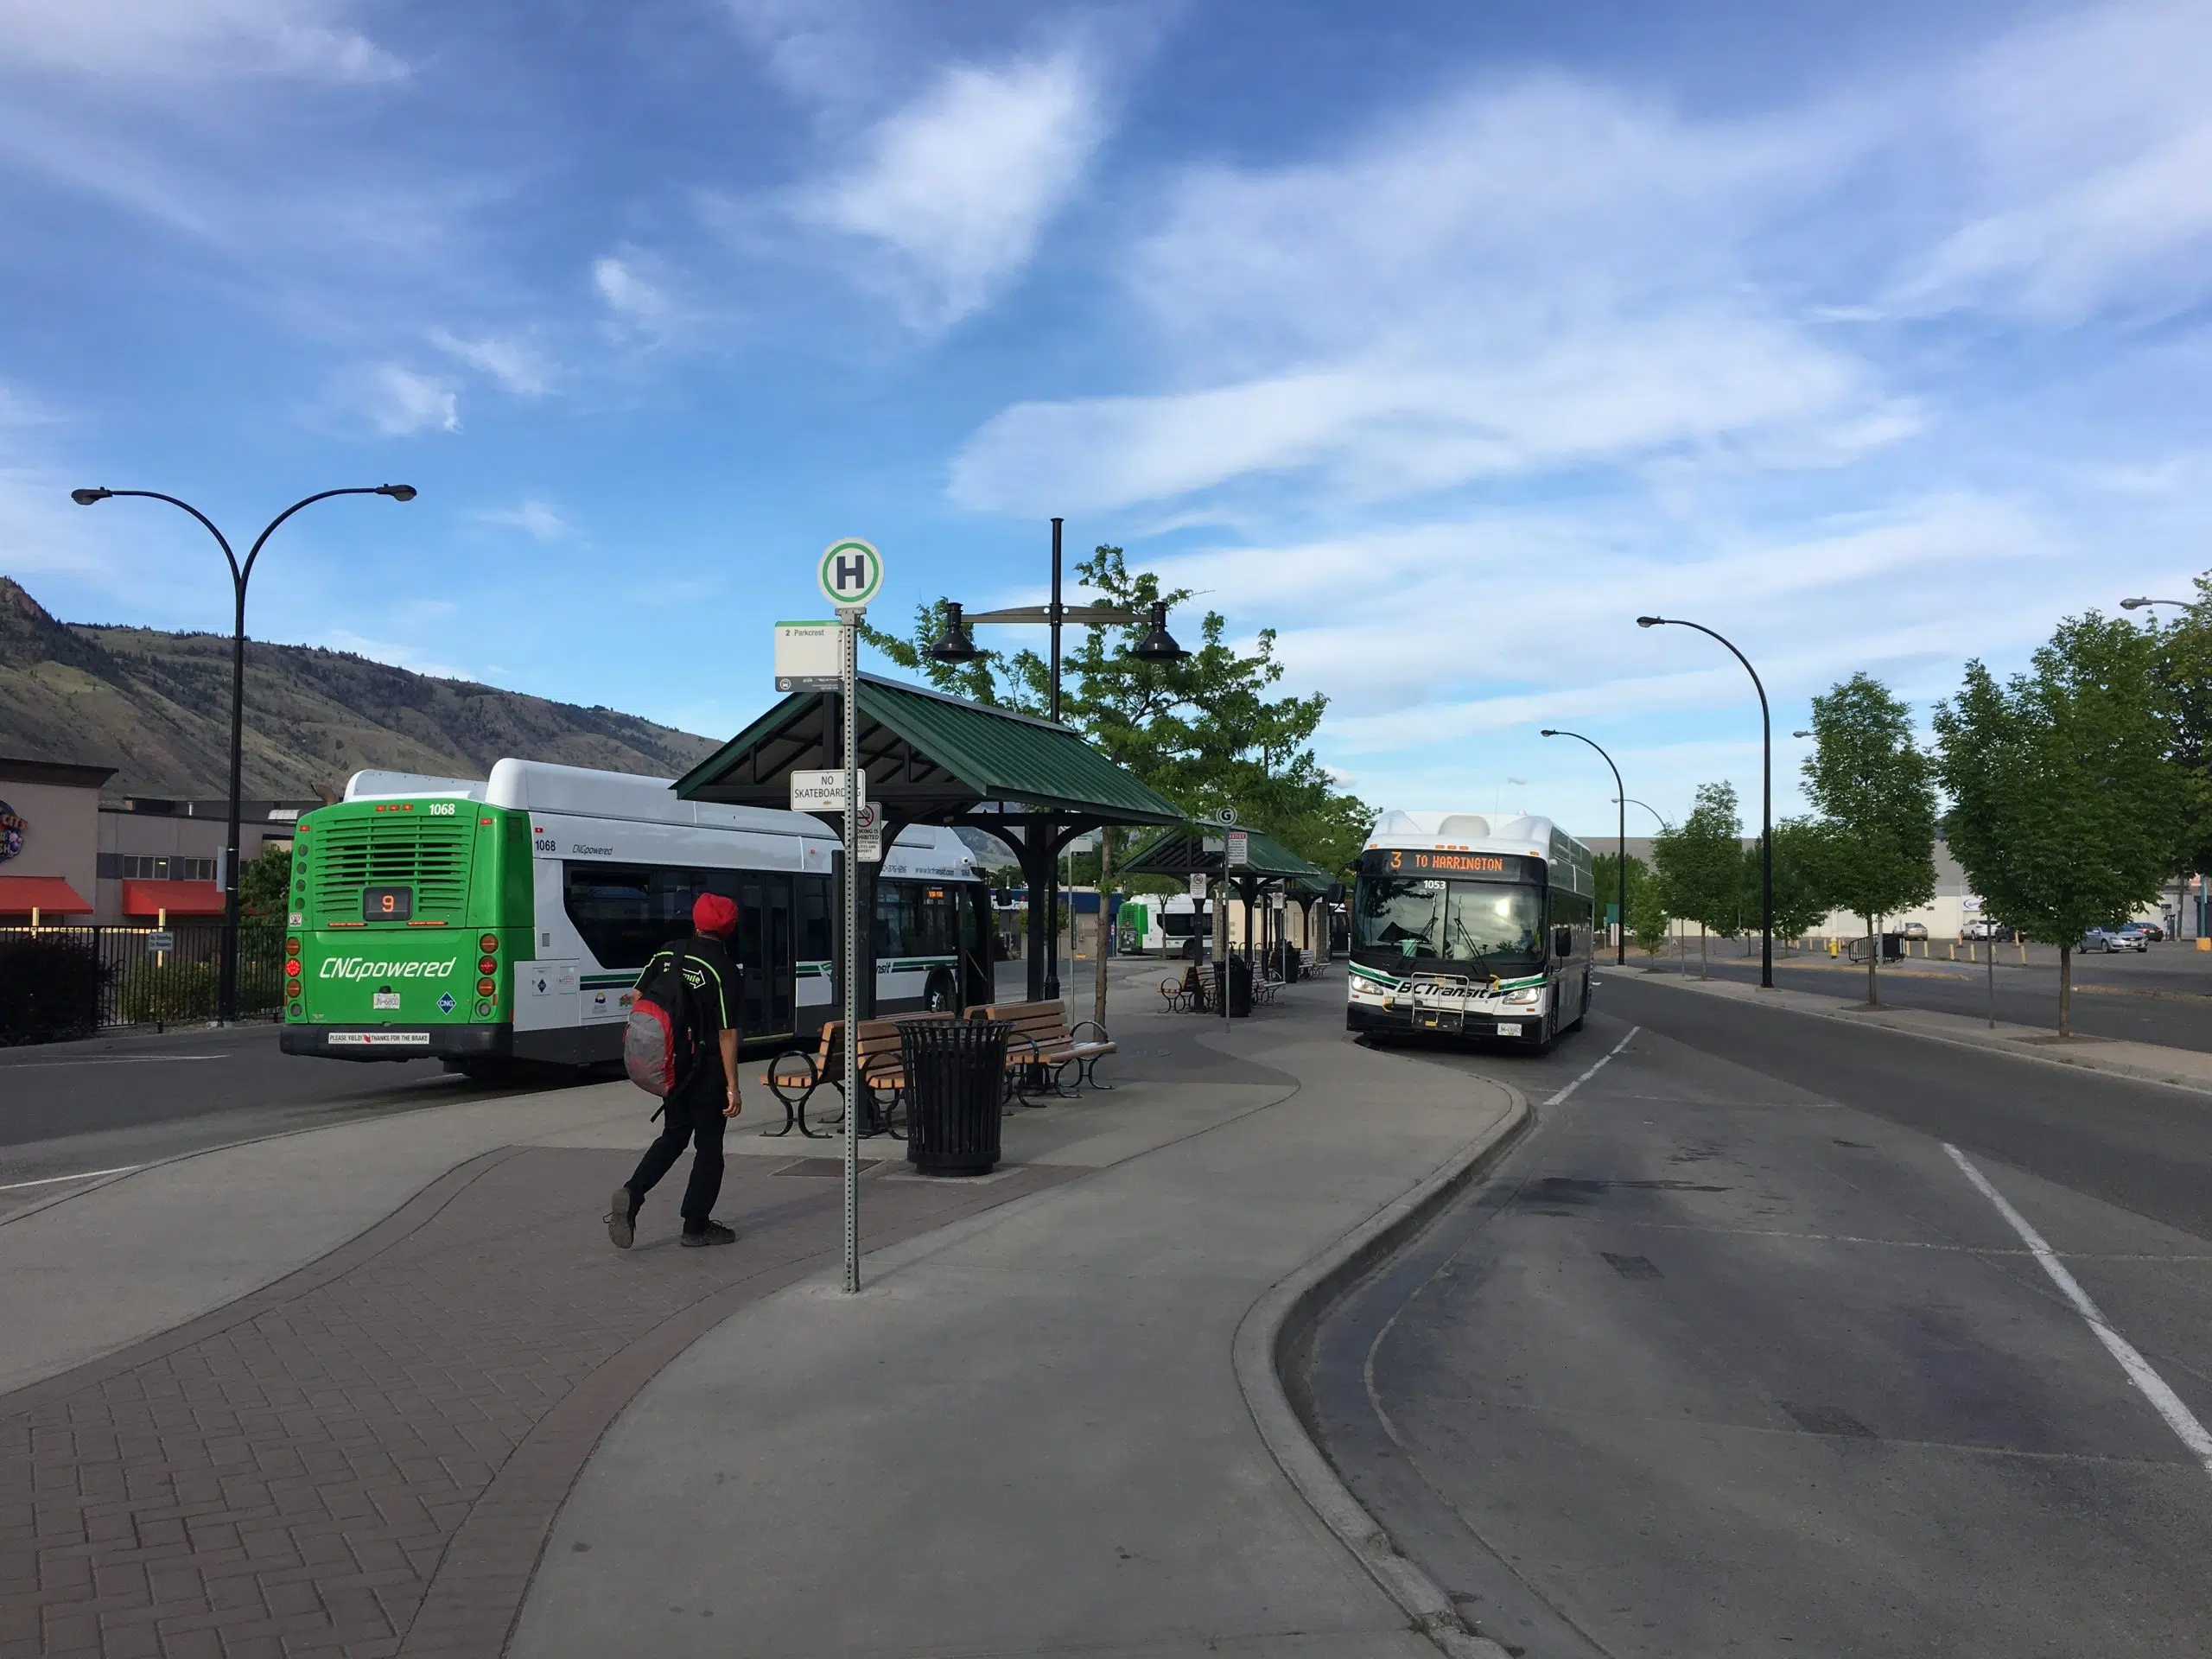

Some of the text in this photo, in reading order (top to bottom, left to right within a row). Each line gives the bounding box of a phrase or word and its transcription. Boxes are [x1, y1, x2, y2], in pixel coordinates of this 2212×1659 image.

[836, 555, 865, 590] H
[821, 776, 834, 785] NO
[794, 787, 861, 798] SKATEBOARDG
[429, 804, 455, 816] 1068
[1221, 810, 1231, 821] G
[535, 839, 556, 852] 1068
[572, 843, 613, 855] CNGpowered
[1390, 851, 1503, 872] 3 TO HARRINGTON
[1423, 880, 1446, 890] 1053
[382, 895, 395, 912] 9
[319, 957, 456, 982] CNGpowered
